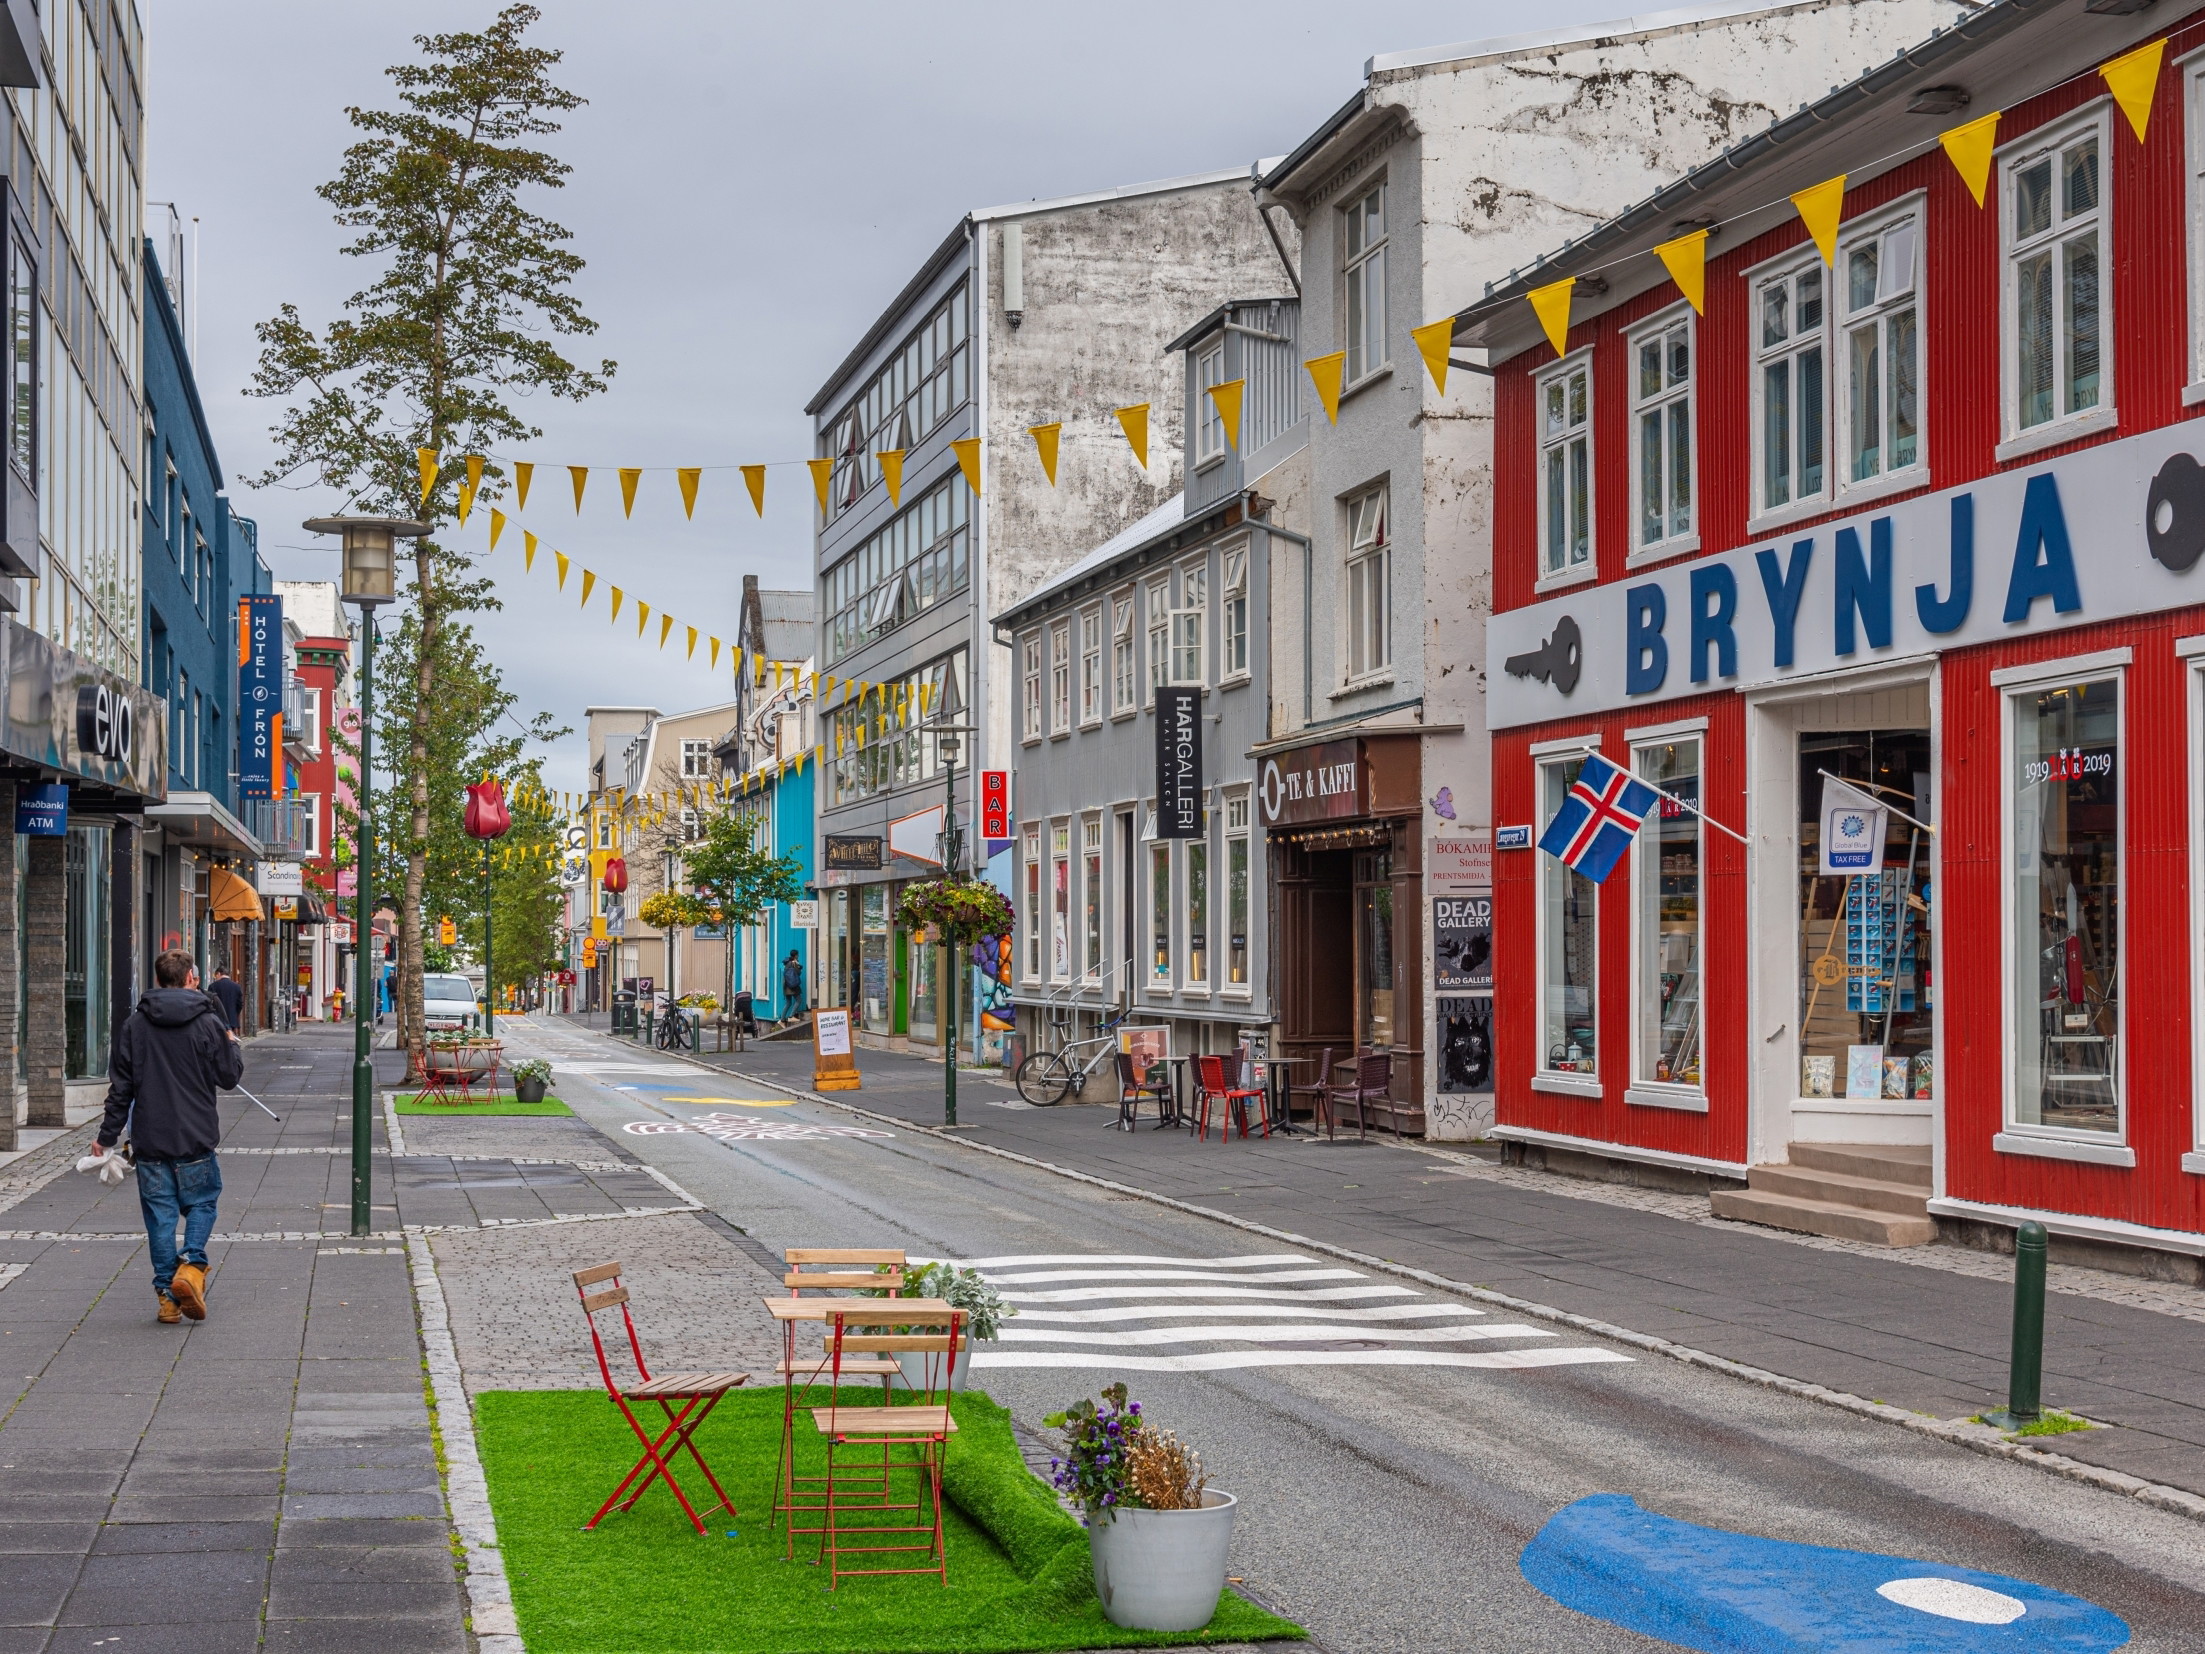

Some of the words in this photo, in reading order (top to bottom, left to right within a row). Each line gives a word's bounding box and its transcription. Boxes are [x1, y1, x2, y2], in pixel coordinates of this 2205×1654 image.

[1626, 471, 2082, 696] BRYNJA
[255, 616, 266, 678] HÓTEL
[96, 685, 131, 762] eva
[254, 708, 266, 758] FRÓN
[2025, 761, 2049, 784] 1919
[2083, 753, 2111, 776] 2019
[1286, 772, 1302, 800] TE
[1306, 769, 1315, 798] &
[1318, 762, 1356, 796] KAFFI
[20, 800, 64, 810] Hraðbanki
[988, 774, 1002, 834] BAR
[28, 817, 54, 828] ATM
[1854, 841, 1868, 849] Blue
[1835, 855, 1848, 864] TAX
[1849, 855, 1867, 863] FREE
[1437, 901, 1491, 918] DEAD
[1437, 916, 1491, 928] GALLERY
[1440, 977, 1461, 985] DEAD
[1440, 998, 1492, 1013] DEAD
